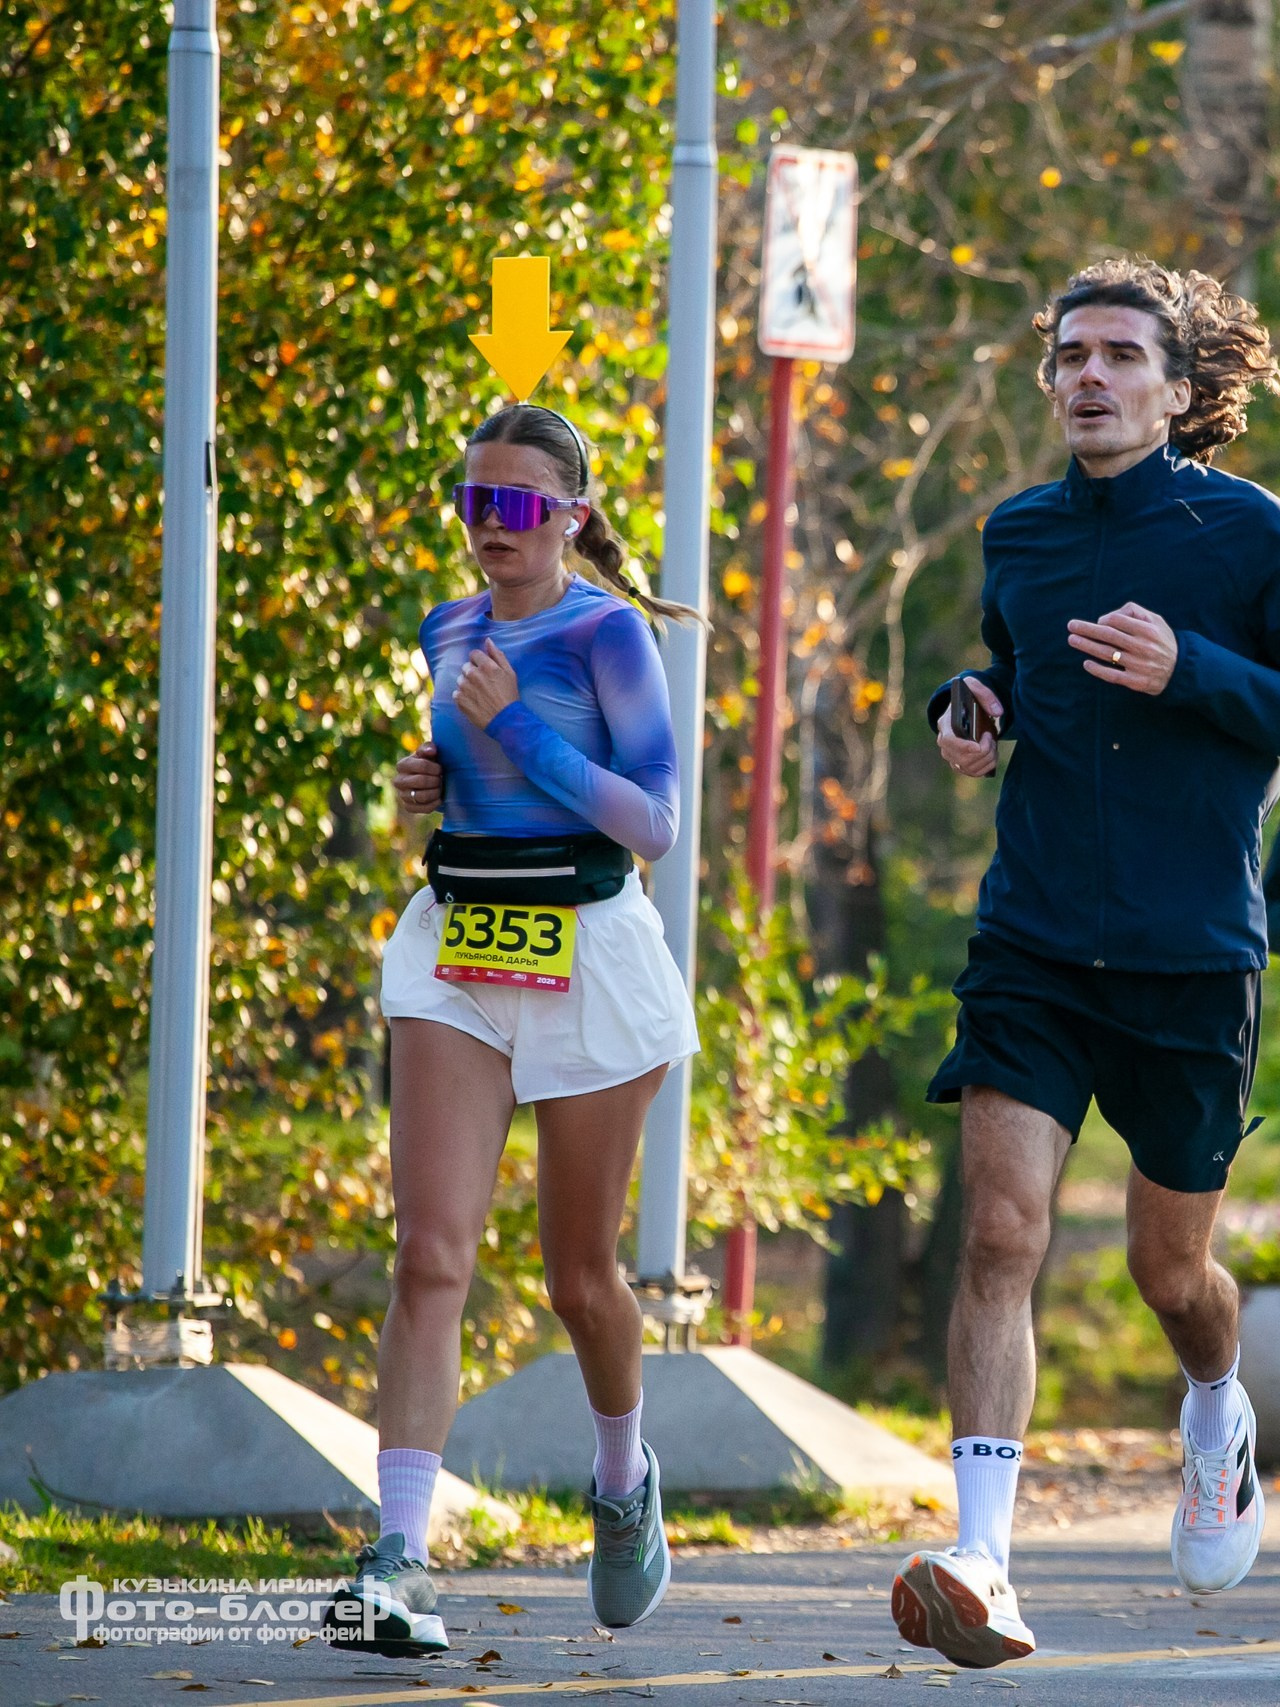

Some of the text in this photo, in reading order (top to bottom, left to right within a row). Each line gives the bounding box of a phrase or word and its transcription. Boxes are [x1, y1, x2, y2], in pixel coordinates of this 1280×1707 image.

[445, 905, 563, 957] 5353
[454, 951, 539, 967] ЛУКЬЯНОВА ДАРЬЯ
